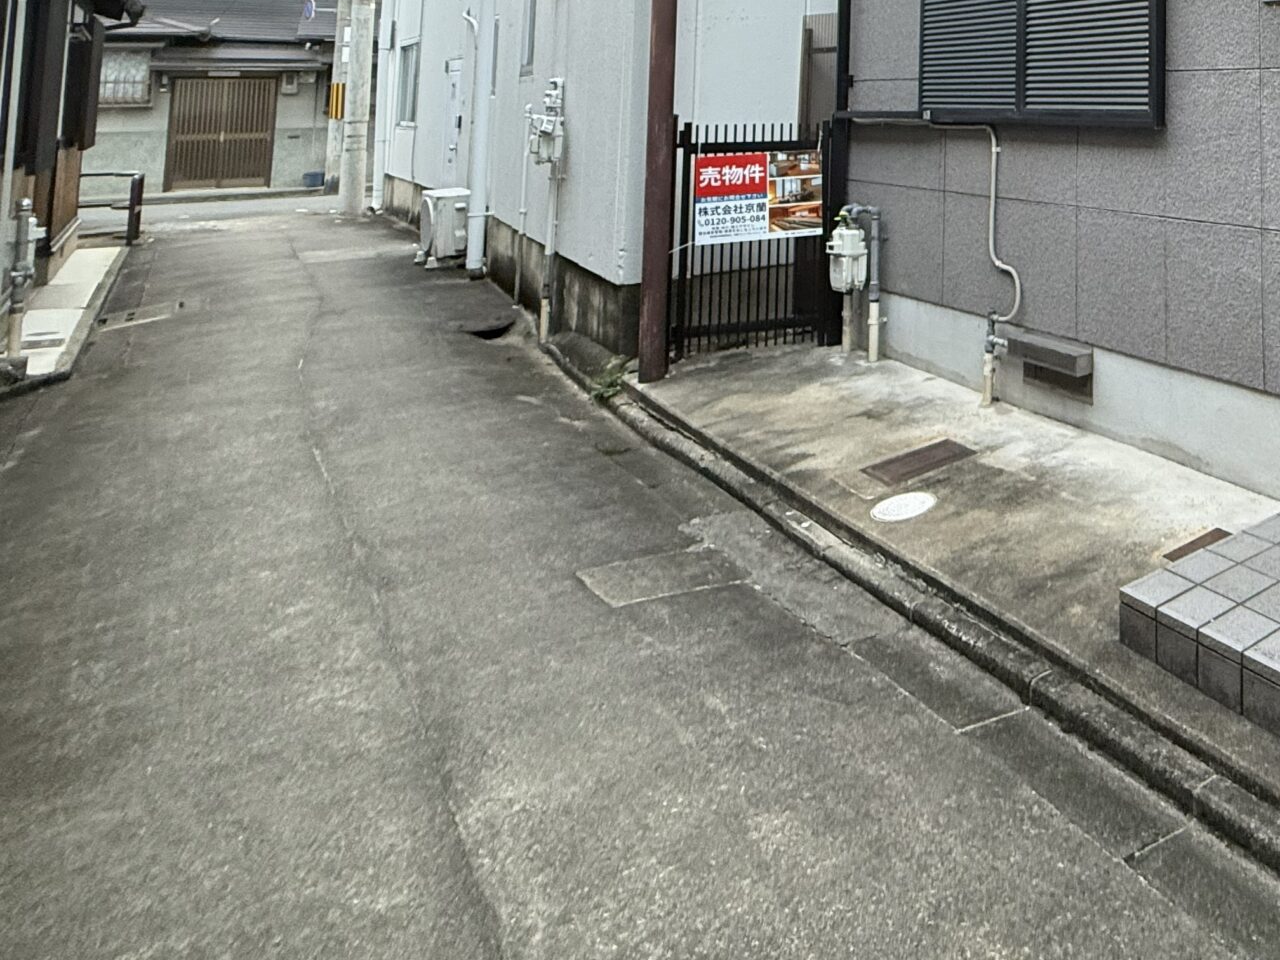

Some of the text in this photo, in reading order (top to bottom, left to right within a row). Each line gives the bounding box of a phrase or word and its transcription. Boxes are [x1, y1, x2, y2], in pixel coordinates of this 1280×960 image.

[699, 163, 765, 187] 売物件
[704, 214, 766, 226] 0120-905-084
